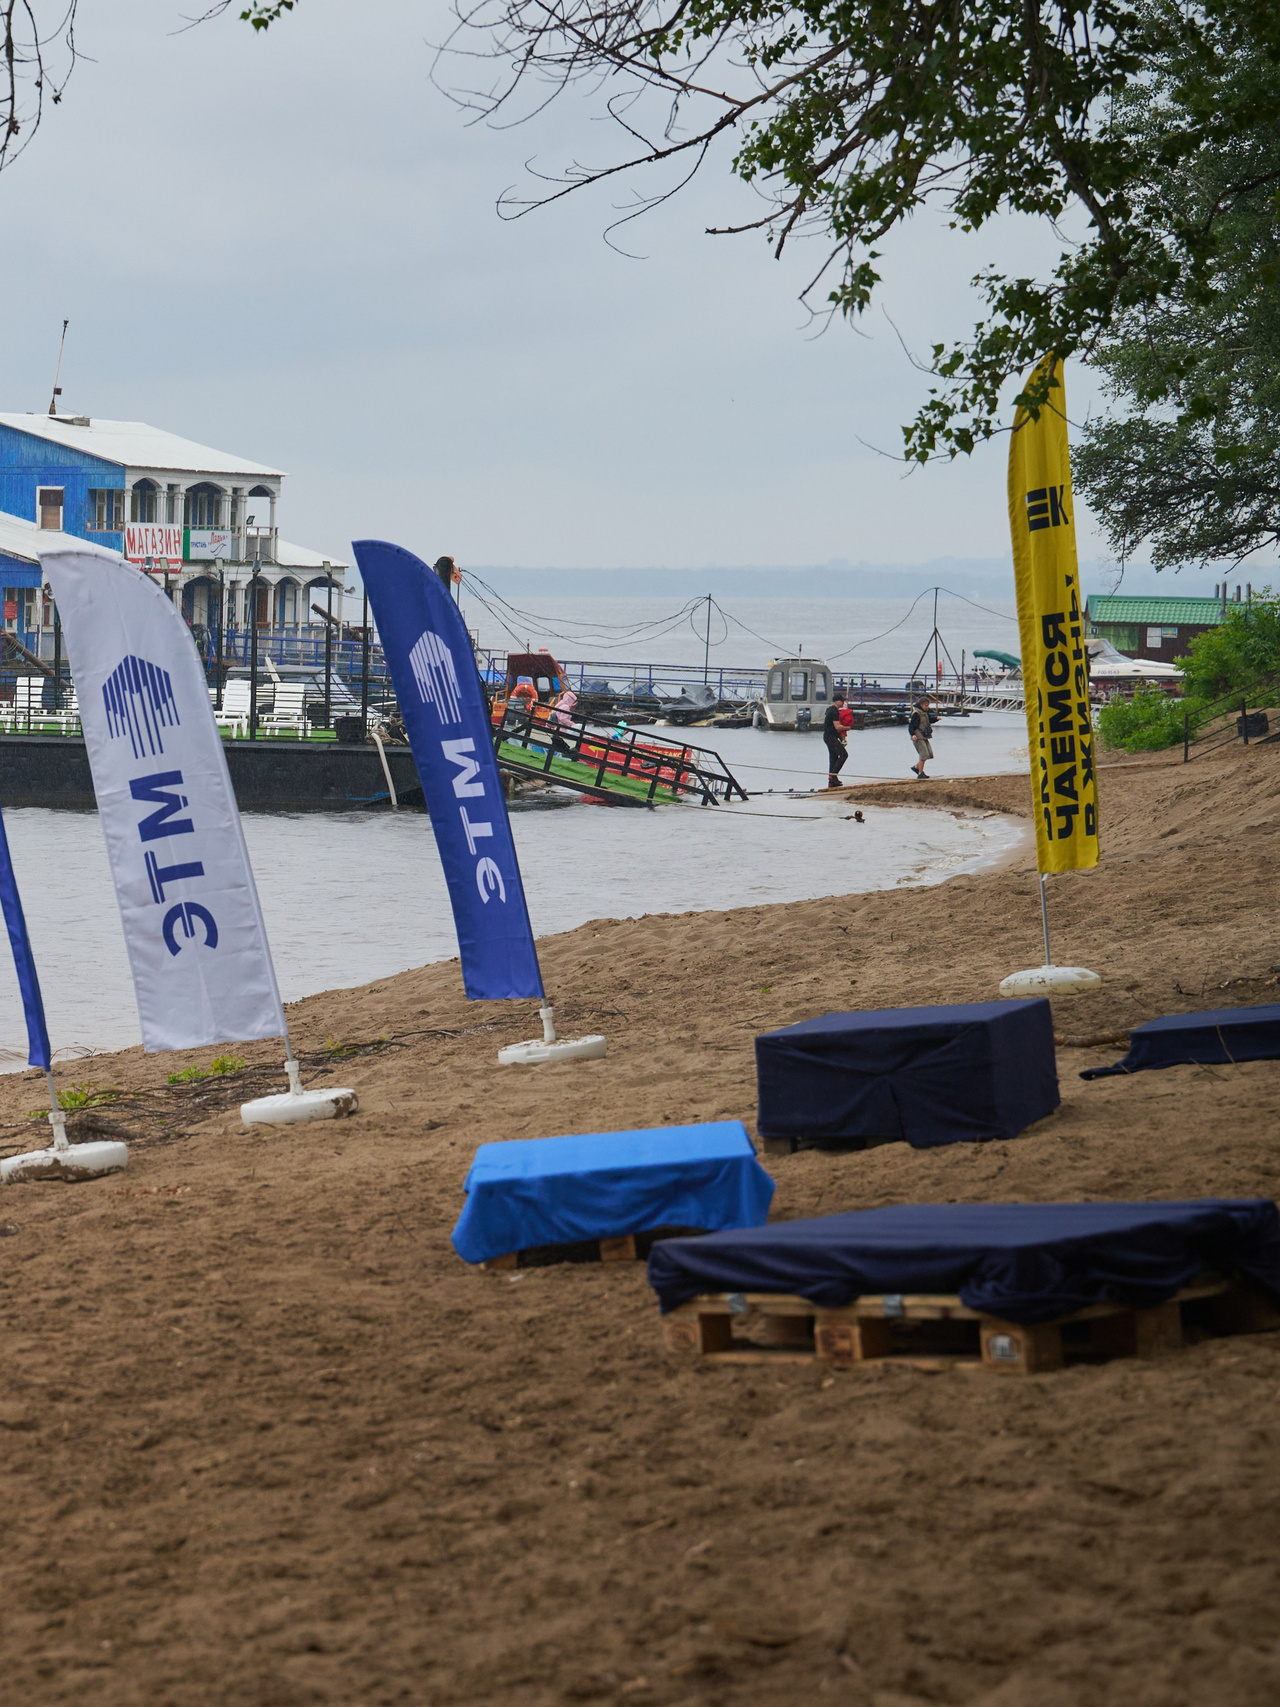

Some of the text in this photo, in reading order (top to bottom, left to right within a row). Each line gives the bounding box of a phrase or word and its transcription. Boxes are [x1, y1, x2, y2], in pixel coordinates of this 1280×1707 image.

[127, 527, 180, 555] МАГАЗИН
[1042, 612, 1079, 840] ЧАЕМСЯ
[129, 770, 218, 957] ЭТМ
[441, 737, 506, 904] ЭТМ
